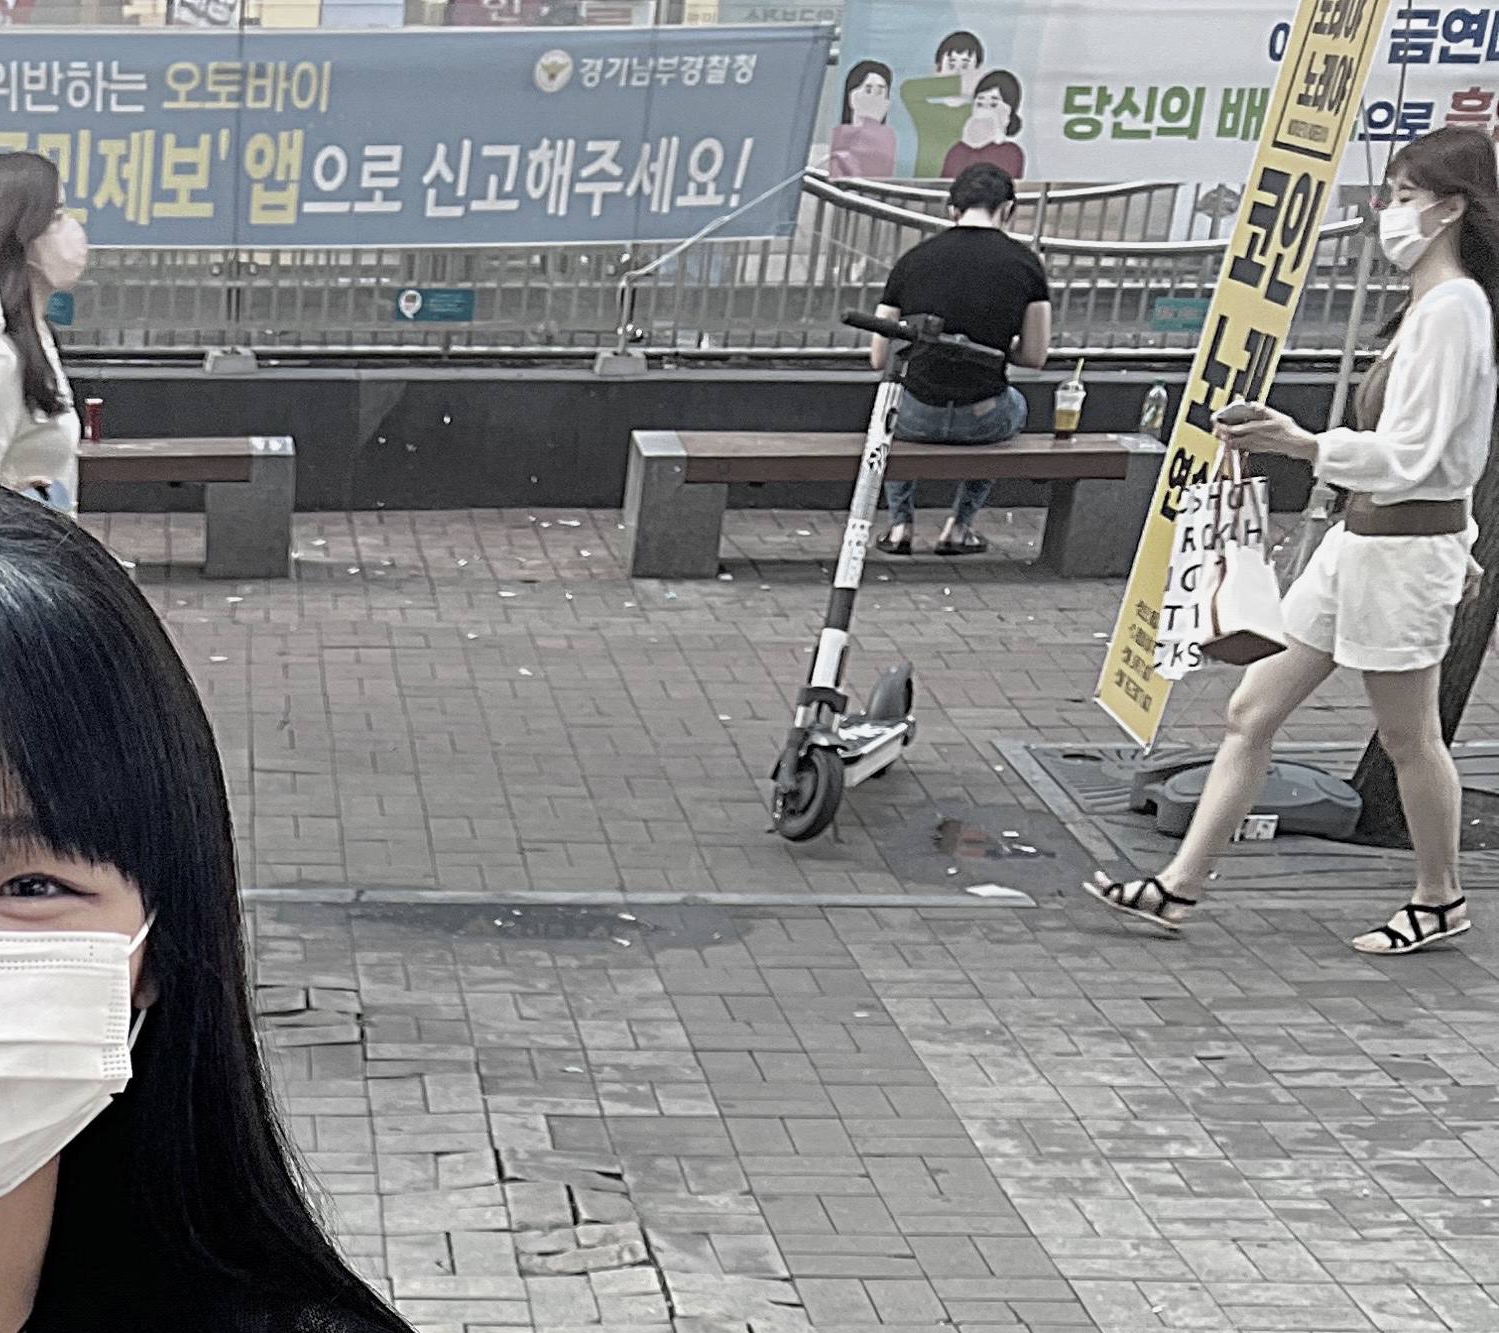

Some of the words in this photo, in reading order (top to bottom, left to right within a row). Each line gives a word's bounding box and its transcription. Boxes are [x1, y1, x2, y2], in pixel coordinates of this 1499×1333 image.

[162, 60, 332, 113] 오토바이
[579, 54, 757, 88] 경기남부경찰청
[1062, 86, 1206, 141] 당신의
[244, 129, 402, 225] 앱으로
[422, 136, 755, 217] 신고해주세요!
[1229, 167, 1327, 307] 코인
